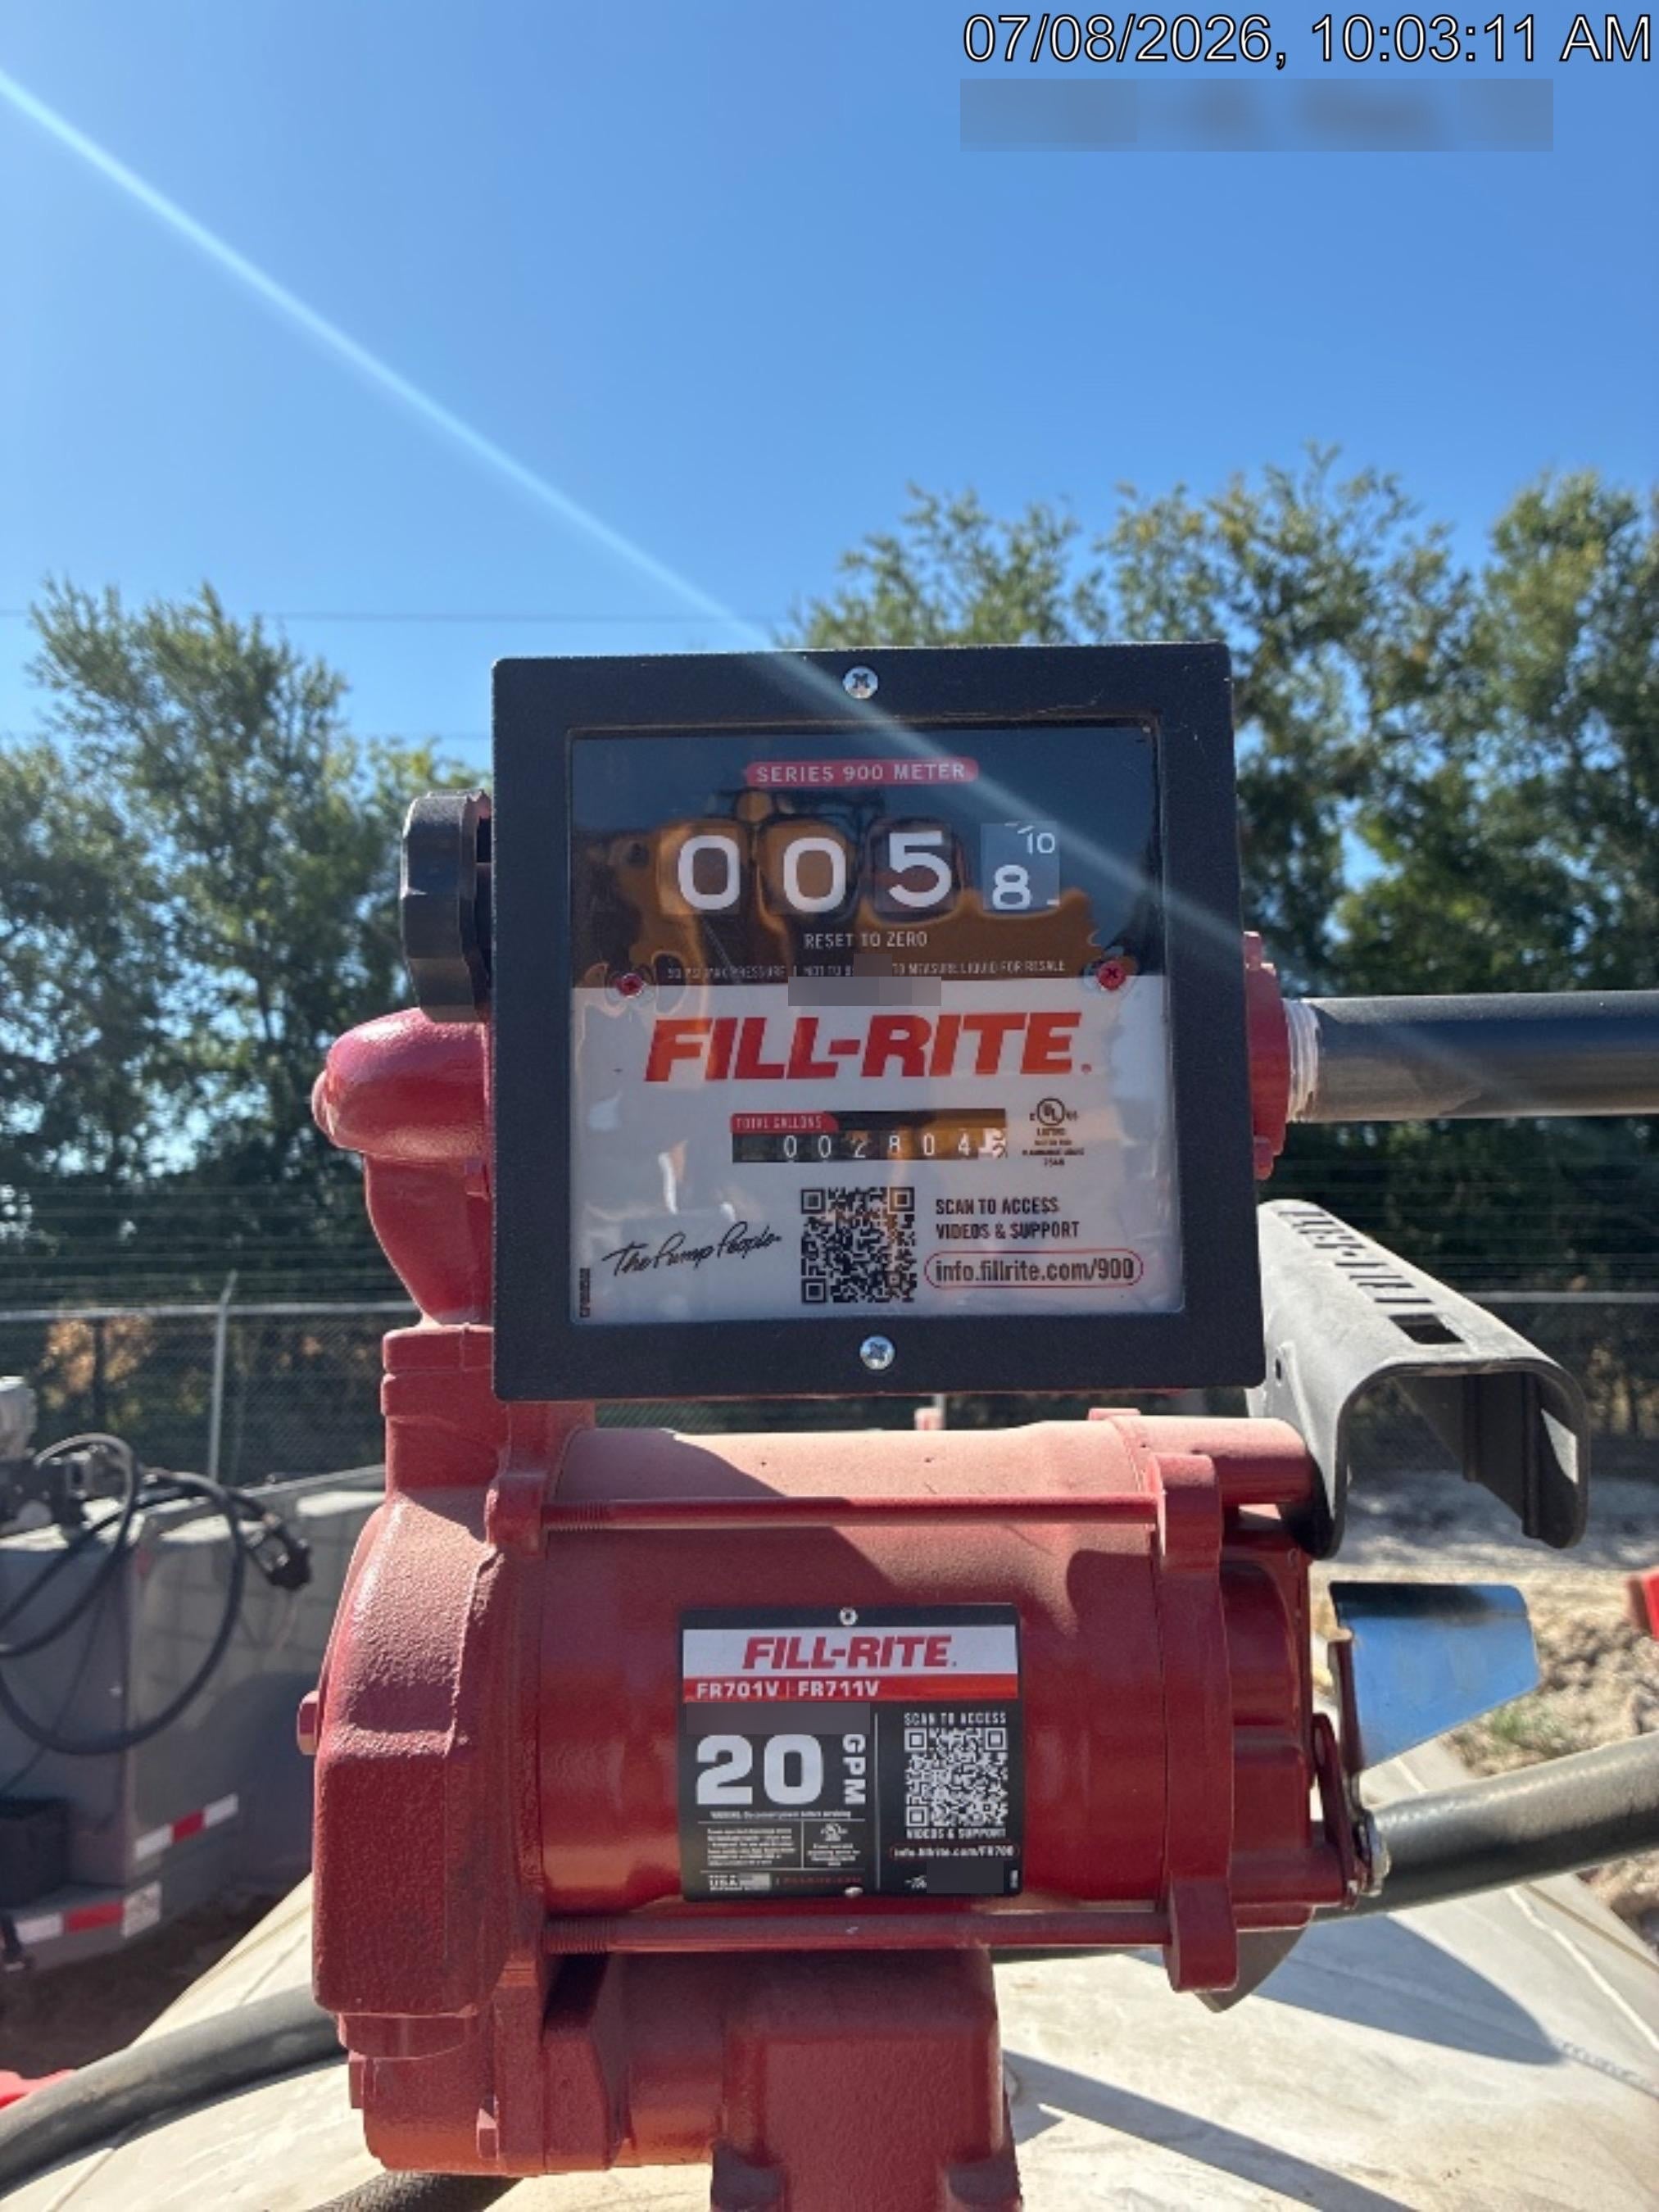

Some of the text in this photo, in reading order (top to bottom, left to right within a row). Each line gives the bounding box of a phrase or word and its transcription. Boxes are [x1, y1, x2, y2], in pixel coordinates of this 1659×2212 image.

[756, 763, 965, 782] SERIES 900 METER
[804, 931, 928, 950] RESET TO ZERO
[936, 1196, 1060, 1215] SCAN TO ACCESS
[936, 1222, 1080, 1240] VIDEOS & SUPPORT
[936, 1258, 1135, 1282] info.fillrite.com/900
[696, 1679, 882, 1699] FR701V FR711V
[904, 1712, 936, 1726] SCAN
[960, 1711, 1007, 1725] ACCESS
[696, 1734, 825, 1806] 20
[842, 1734, 867, 1805] GPM
[958, 1827, 1007, 1839] SUPPORT
